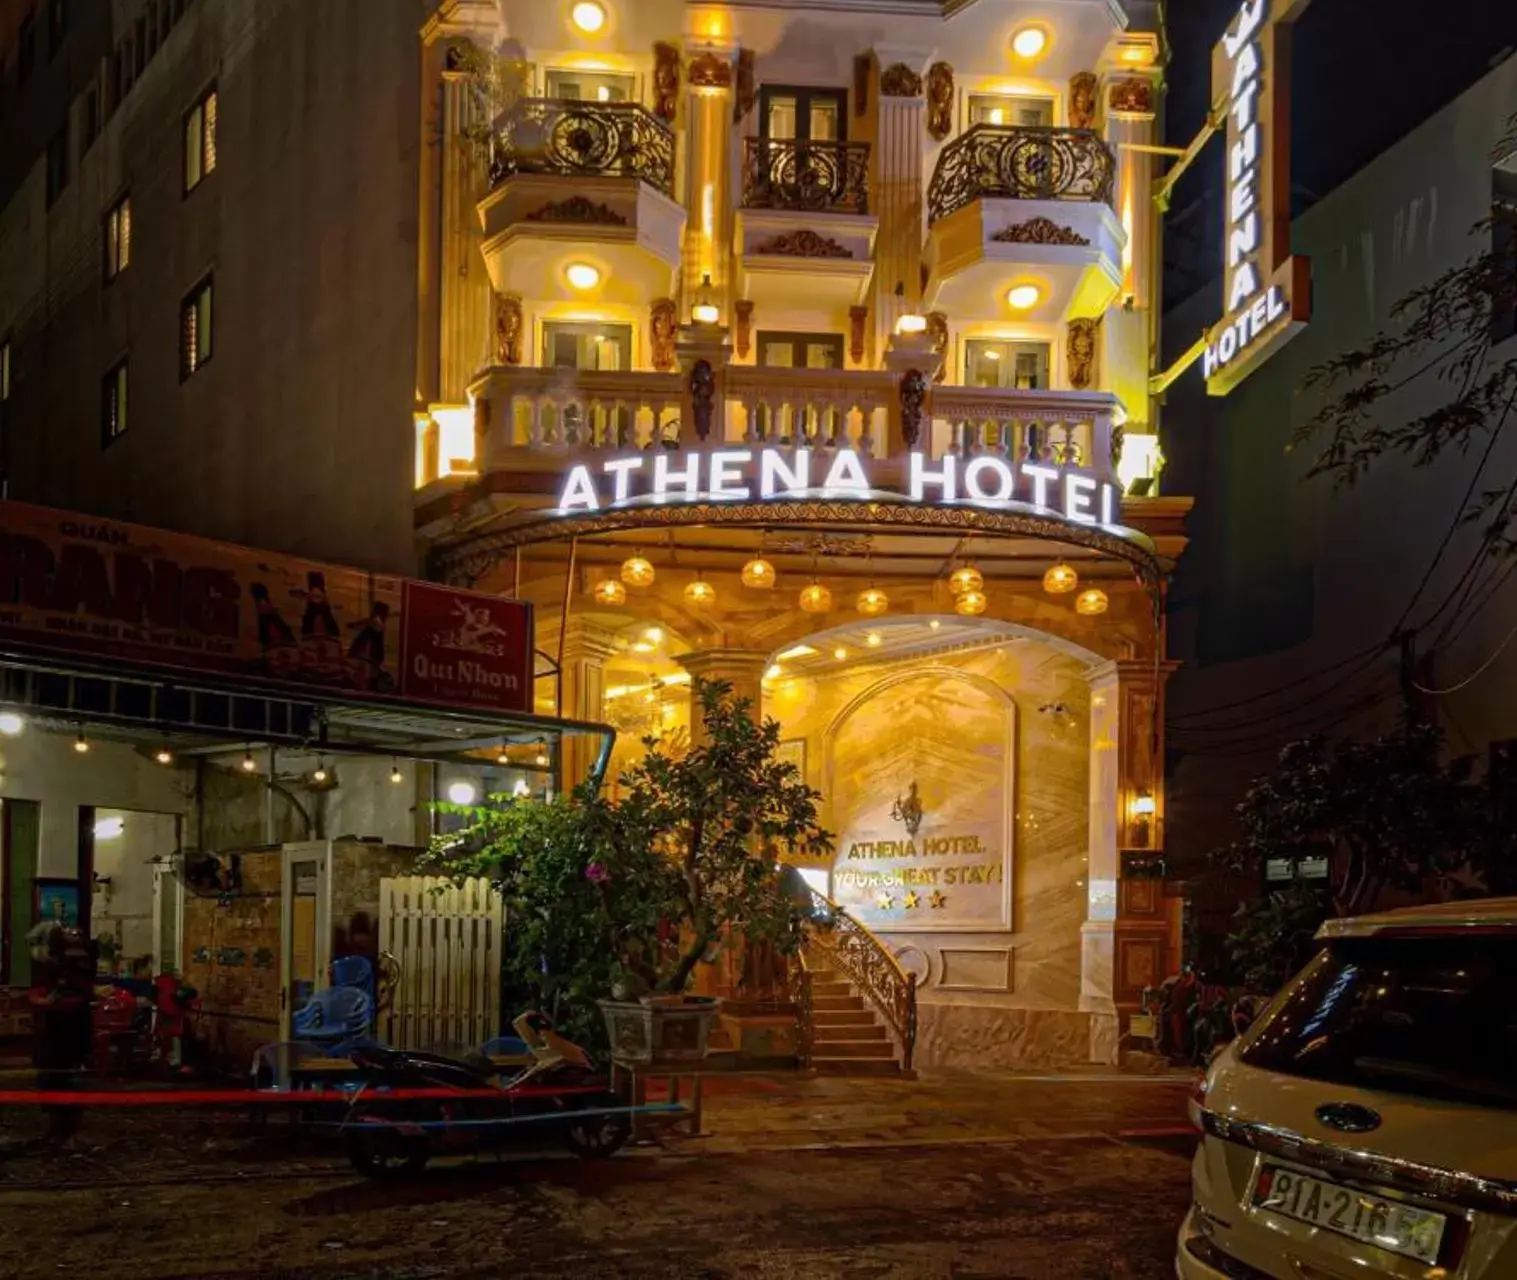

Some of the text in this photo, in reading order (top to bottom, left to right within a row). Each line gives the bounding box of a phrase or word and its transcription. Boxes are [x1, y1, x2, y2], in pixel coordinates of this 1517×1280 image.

[1230, 45, 1259, 310] ATHENA
[1203, 284, 1284, 379] HOTEL
[559, 449, 871, 512] ATHENA
[848, 839, 916, 860] ATHENA
